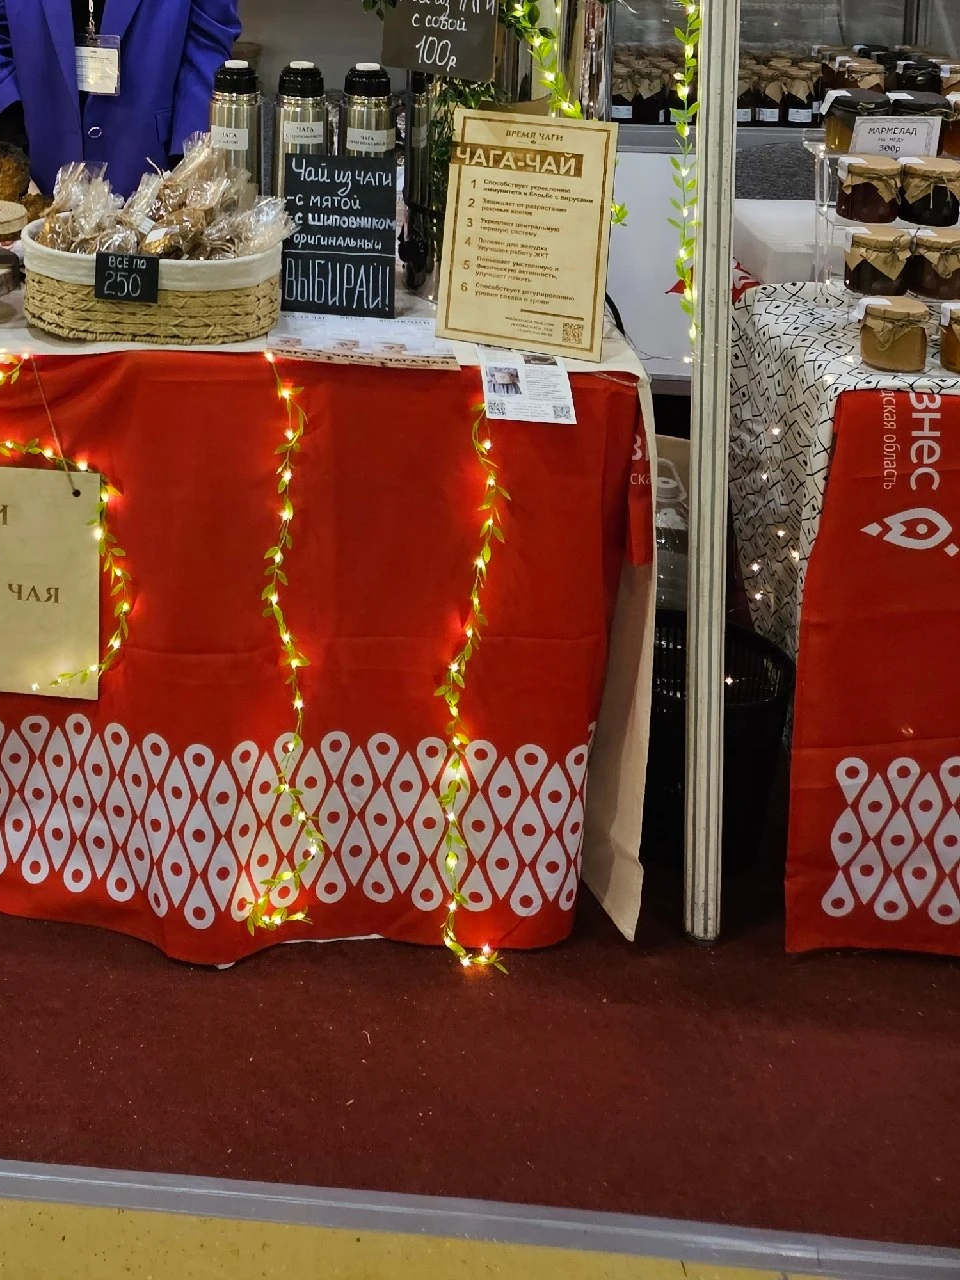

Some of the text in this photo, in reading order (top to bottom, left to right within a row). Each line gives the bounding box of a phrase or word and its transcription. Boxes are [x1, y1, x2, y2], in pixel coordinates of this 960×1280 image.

[425, 14, 468, 32] собой
[505, 129, 564, 142] ВРЕМЯ ЧАГИ
[867, 127, 917, 136] МАРМЕЛАД
[879, 144, 901, 153] 300р
[456, 144, 577, 176] ЧАГА-ЧАЙ
[291, 157, 392, 196] Чай из ЧАГИ
[471, 179, 477, 189] 1
[309, 194, 361, 210] мятой
[467, 198, 475, 208] 2
[560, 195, 594, 205] вирусами
[307, 212, 397, 231] шиповником
[466, 218, 473, 228] 3
[464, 236, 472, 247] 4
[462, 260, 470, 270] 5
[103, 271, 142, 297] 250
[284, 257, 390, 311] ВЫБИРАЙ!
[460, 282, 468, 292] 6
[883, 434, 901, 490] область
[7, 582, 61, 604] ЧАЯ
